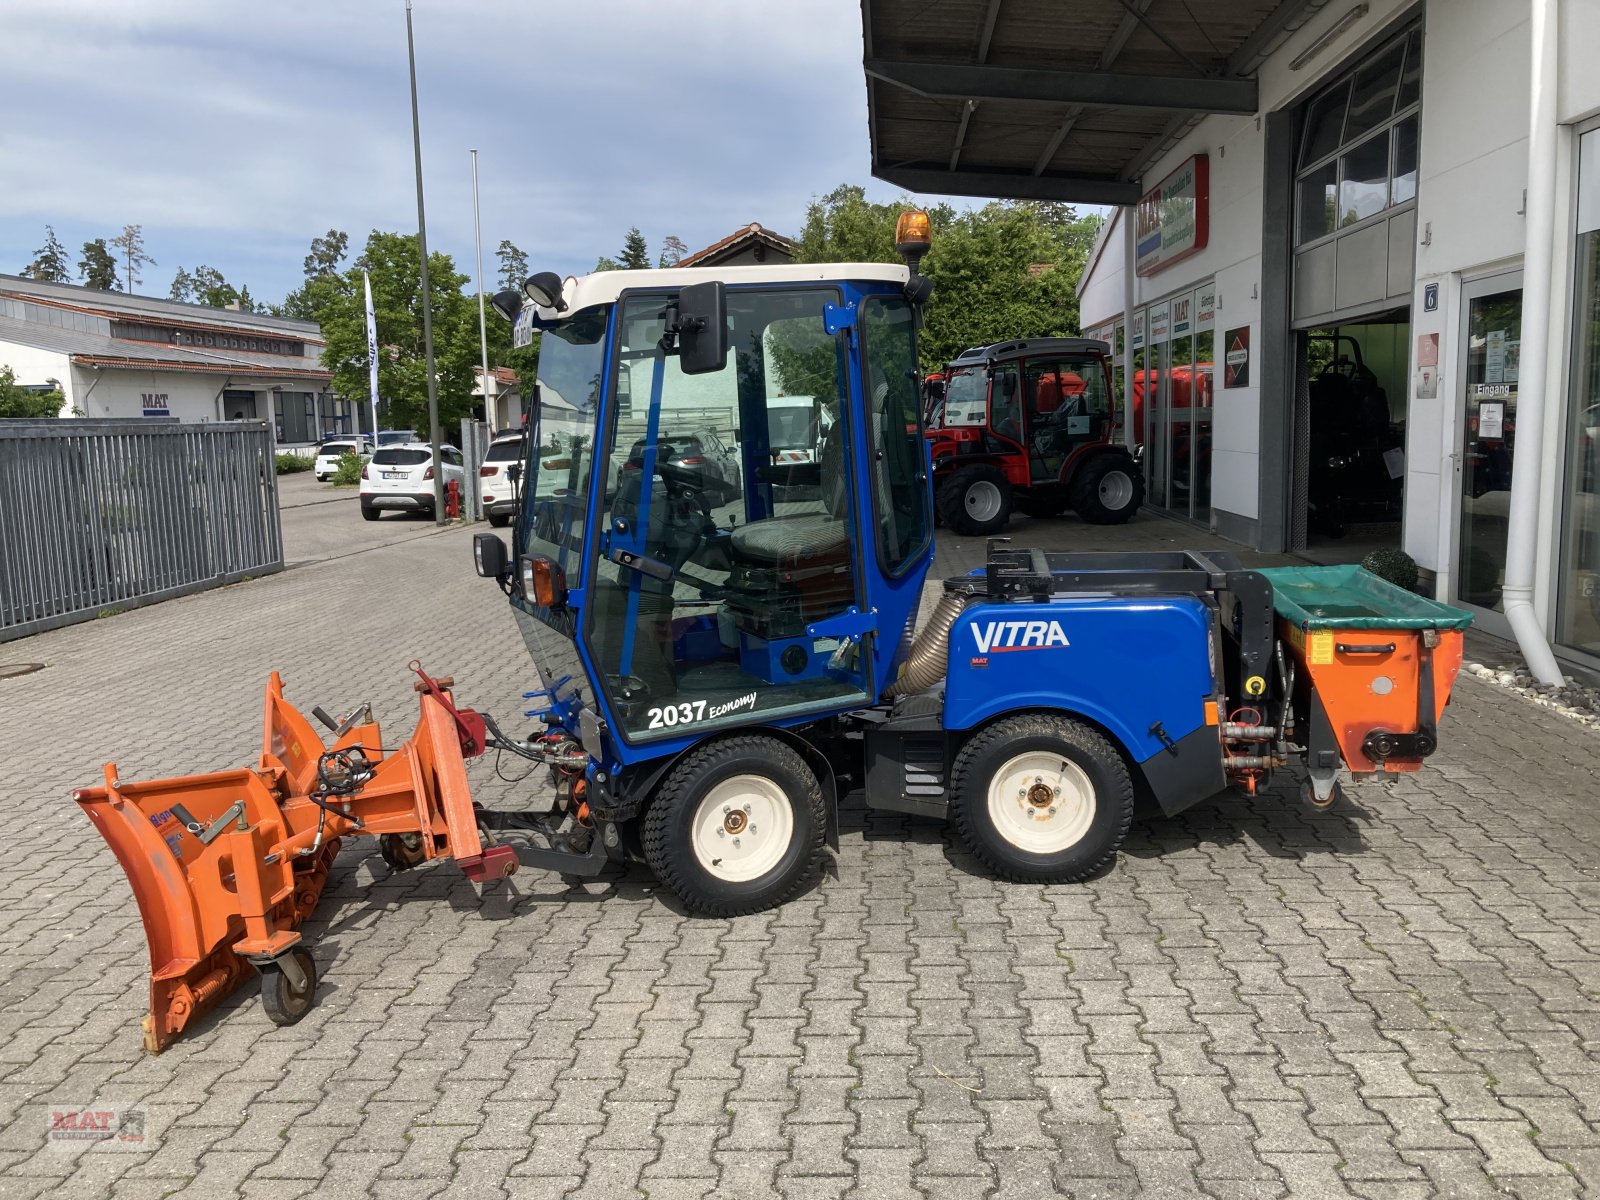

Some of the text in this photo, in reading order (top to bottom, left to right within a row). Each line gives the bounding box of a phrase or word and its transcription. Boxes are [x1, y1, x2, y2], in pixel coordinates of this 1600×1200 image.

[1427, 292, 1434, 306] 6
[1174, 299, 1190, 323] MAT
[1477, 384, 1510, 396] Eingang
[141, 393, 168, 408] MAT
[970, 620, 1070, 653] VITRA
[647, 691, 757, 730] 2037 Economy
